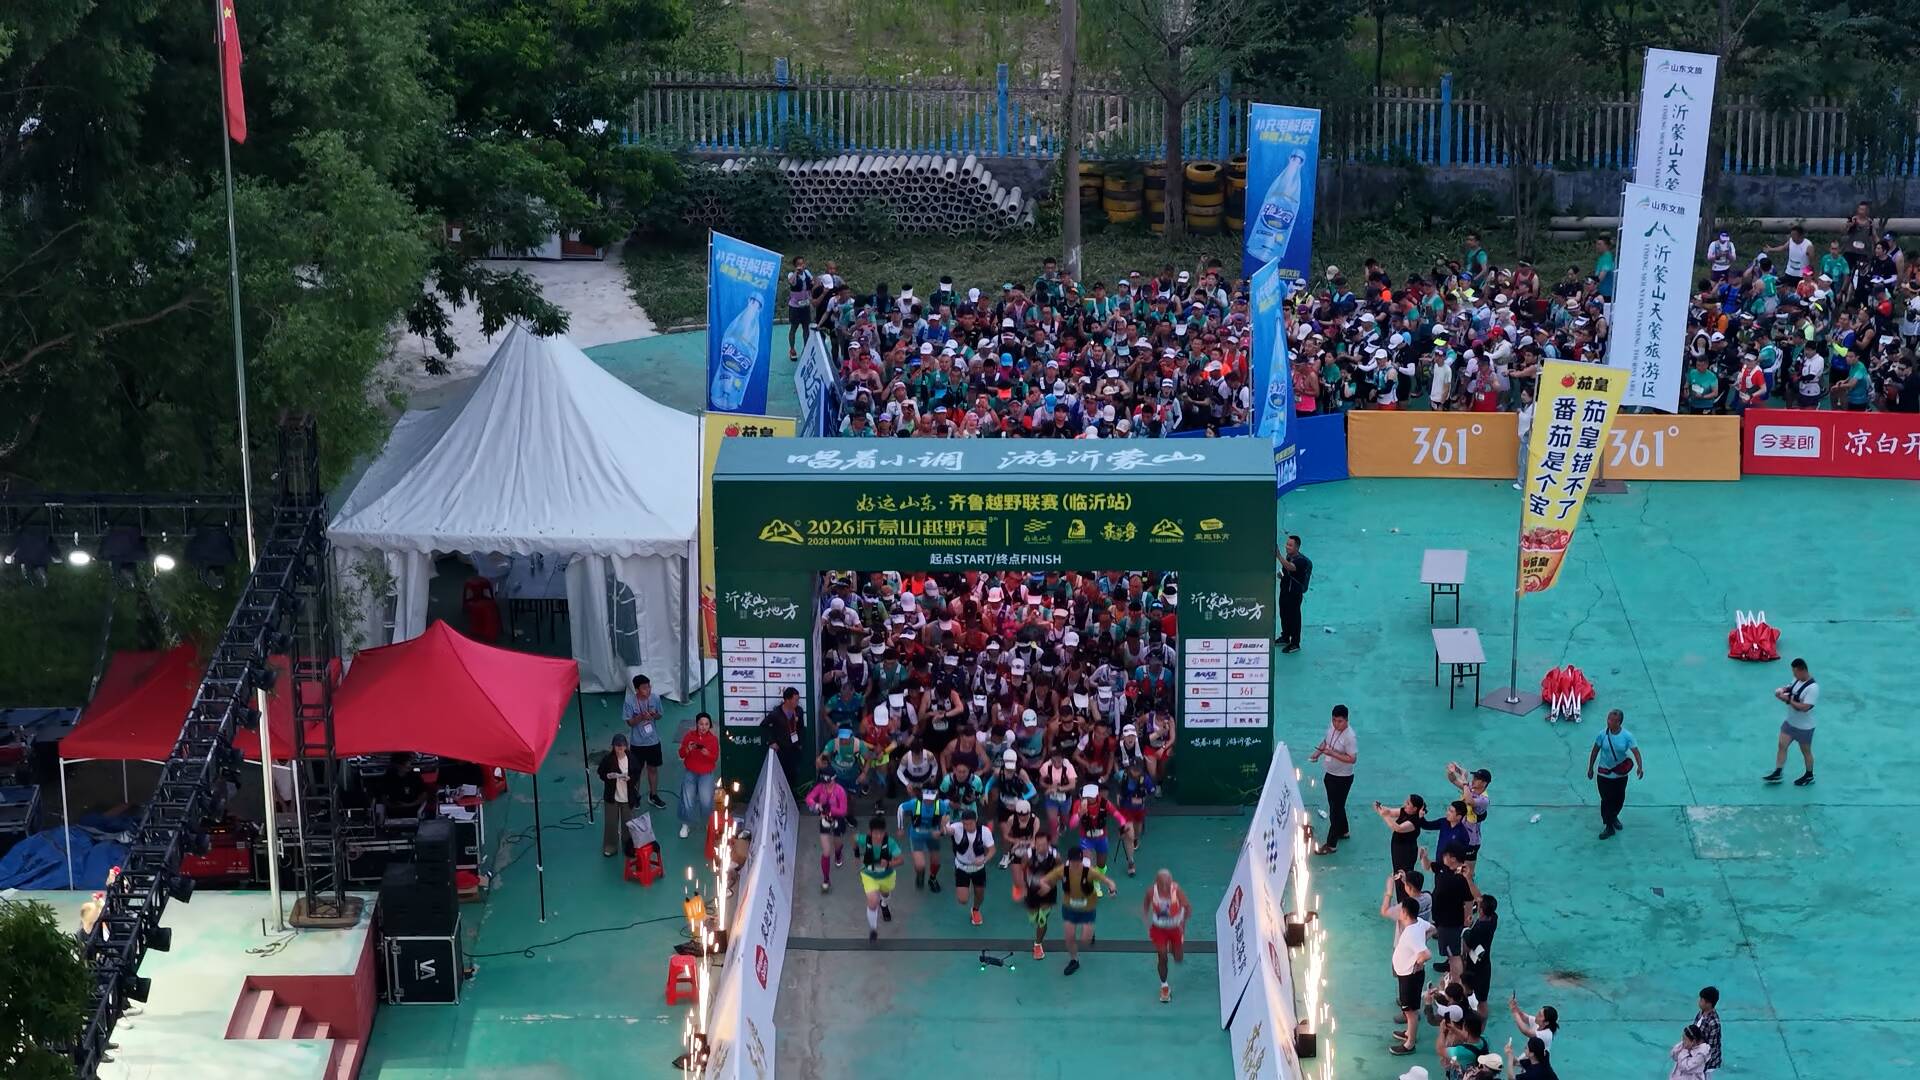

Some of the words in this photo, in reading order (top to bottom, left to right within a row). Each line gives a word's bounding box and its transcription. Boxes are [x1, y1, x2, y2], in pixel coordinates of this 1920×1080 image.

[1641, 243, 1671, 398] 沂蒙山天蒙旅游区
[1576, 376, 1609, 392] 茄皇
[1412, 424, 1483, 465] 361°
[1609, 425, 1680, 467] 361°
[1760, 433, 1814, 451] 今麦郎
[786, 448, 964, 471] 唱着小调
[997, 447, 1205, 471] 游沂蒙山
[1530, 397, 1577, 517] 番茄是个宝
[1557, 399, 1608, 519] 茄皇错不了
[807, 519, 987, 535] 2026沂蒙山越野赛
[807, 538, 829, 546] 2026
[830, 538, 861, 546] MOUNT
[862, 538, 895, 546] YIMENG
[896, 538, 921, 546] TRAIL
[923, 538, 962, 546] RUNNING
[964, 538, 987, 546] RACE
[930, 553, 1062, 565] 起点START/终点FINISH
[725, 591, 768, 612] 沂蒙山
[753, 602, 799, 620] 好地方
[1191, 592, 1234, 612] 沂蒙山
[1218, 602, 1265, 620] 好地方
